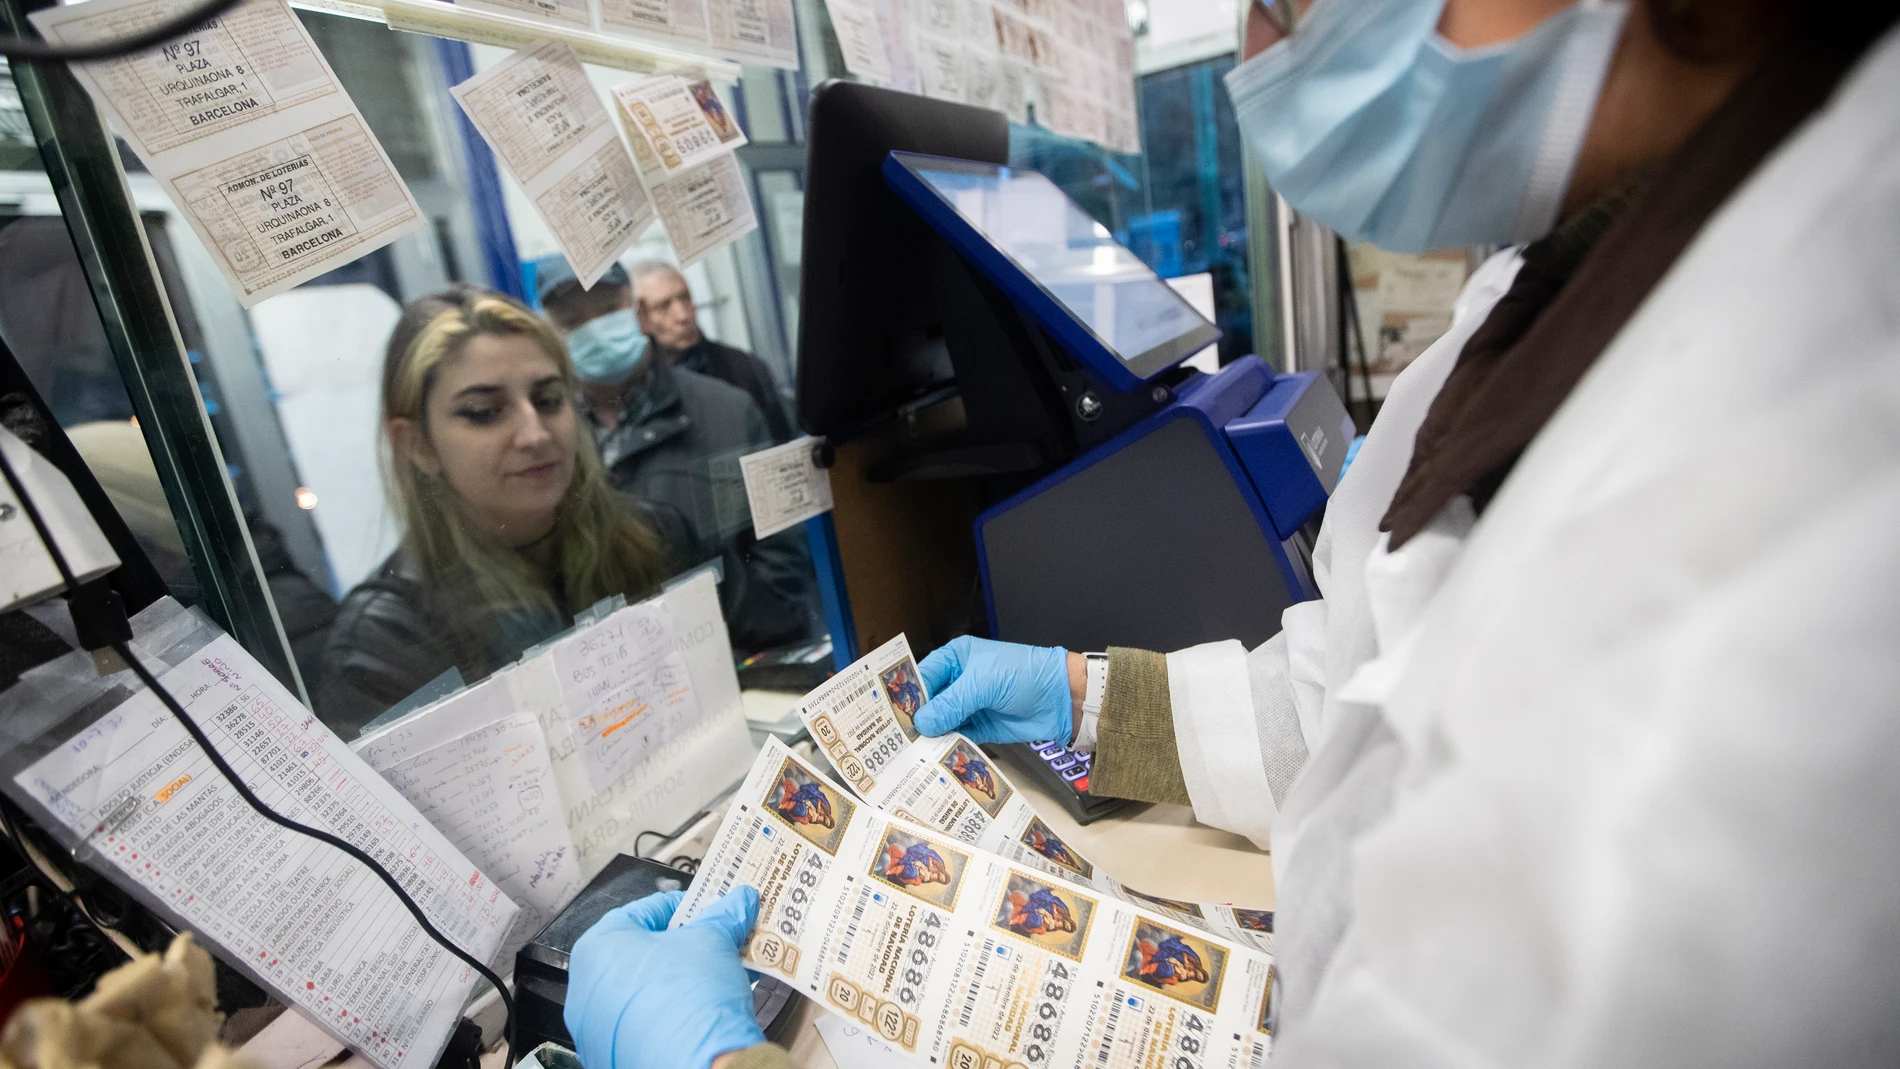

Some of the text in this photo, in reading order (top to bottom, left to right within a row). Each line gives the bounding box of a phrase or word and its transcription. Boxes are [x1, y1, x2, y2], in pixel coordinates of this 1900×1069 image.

[161, 39, 200, 62] Nº 97
[159, 65, 245, 95] URQUINAONA 8
[176, 58, 211, 74] PLAZA
[175, 81, 248, 108] TRAFALGAR, 1
[189, 98, 258, 125] BARCELONA
[227, 159, 309, 193] ADMON. DE LOTERIAS
[259, 178, 293, 202] Nº 97
[256, 198, 331, 233] URQUINAONA 8
[271, 194, 303, 212] PLAZA
[270, 213, 334, 244] TRAFALGAR, 1
[281, 228, 343, 259] BARCELONA
[190, 683, 210, 699] HORA:
[150, 715, 168, 728] DÍA:
[215, 704, 238, 722] 32386
[225, 712, 247, 731] 36278
[257, 706, 274, 719] 40
[859, 712, 875, 727] diciembre
[233, 720, 255, 739] 28515
[243, 728, 264, 748] 31146
[820, 724, 831, 737] 20
[846, 728, 856, 738] 2022
[853, 717, 893, 753] LOTERÍA NACIONAL
[856, 715, 883, 740] DE NAVIDAD
[251, 736, 271, 756] 22657
[260, 745, 281, 764] 87701
[864, 732, 903, 771] 48686
[269, 753, 288, 772] 41017
[277, 762, 298, 780] 21461
[130, 763, 164, 791] JUSTICIA
[286, 769, 306, 788] 41015
[294, 777, 314, 796] 29806
[117, 774, 192, 835] ASSEP SOCIAL)
[303, 784, 323, 804] 88266
[311, 792, 331, 811] 32375
[950, 800, 958, 809] DE
[954, 798, 970, 818] LOTERÍA
[141, 784, 217, 852] CASA DE LAS MANTAS
[320, 800, 339, 819] 32375
[328, 807, 347, 826] 34264
[130, 816, 162, 843] ATENTO
[152, 796, 224, 860] COLEGIO ABOGADOS
[345, 822, 364, 841] 29735
[163, 826, 209, 868] CONSELLERIA
[174, 842, 210, 876] CONSORCI
[202, 826, 247, 869] AGRICULTURA
[212, 834, 256, 877] AGRICULTURA
[777, 852, 787, 866] DE
[216, 839, 286, 910] ESCOLA ADM. PÚBLICA
[757, 837, 785, 888] 22 de diciembre
[206, 864, 244, 902] DRAGADOS
[226, 853, 289, 918] ESCOLA DONA
[410, 879, 426, 897] 95628
[418, 886, 434, 905] 31145
[761, 842, 802, 925] LOTERÍA NACIONAL
[780, 853, 822, 935] 48686
[237, 878, 281, 925] ESCOLA THAU
[248, 865, 310, 933] INSTITUT DEL TEATRE
[259, 876, 316, 941] JUBILADOS OLIVETTI
[268, 875, 331, 948] LABORATORIOS MERCK
[278, 865, 356, 956] MAGISTRATURA SOCIAL)
[287, 898, 342, 964] MUNDO DEPORTIVO
[867, 901, 898, 980] 22 de diciembre de 2022
[878, 916, 903, 974] DE NAVIDAD
[297, 941, 323, 972] POLÍTICA
[363, 923, 421, 1003] (TRIBUNAL JUSTICIA)
[882, 905, 917, 993] LOTERÍA NACIONAL
[900, 912, 940, 1003] 48686
[307, 960, 324, 979] SABA
[317, 968, 333, 987] SABA
[402, 942, 431, 985] GENERALITAT
[414, 967, 427, 987] HOSP
[326, 972, 344, 994] SURIS
[336, 960, 368, 1000] TELEFONICA
[364, 960, 408, 1022] VETERANOS IBERIA
[839, 987, 851, 1002] 20
[991, 953, 1023, 1041] 22 de diciembre de 2022
[415, 999, 433, 1026] BARRIO
[1004, 988, 1020, 1032] NAVIDAD
[1026, 963, 1068, 1062] 48686
[1008, 1004, 1026, 1053] NACIONAL
[1135, 1005, 1155, 1064] 22 de diciembre
[1153, 1020, 1162, 1035] DE
[1160, 1007, 1176, 1052] LOTERÍA
